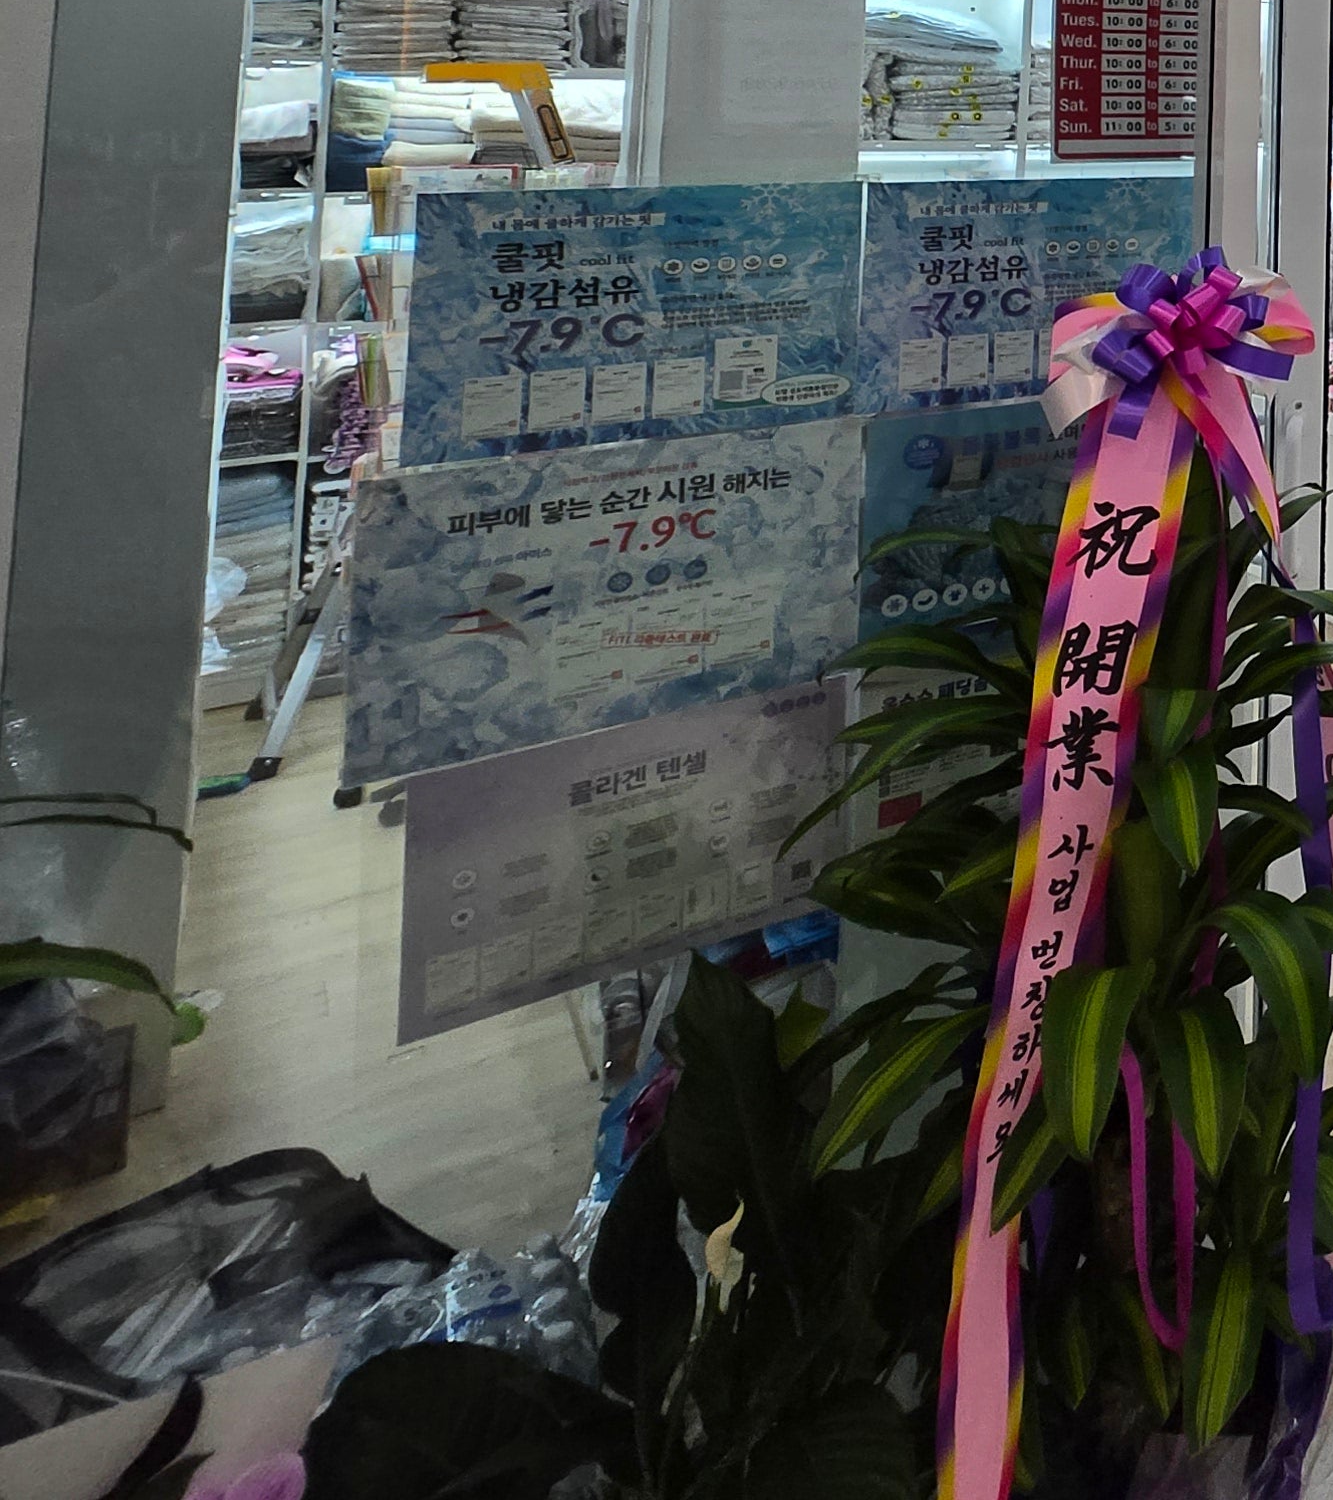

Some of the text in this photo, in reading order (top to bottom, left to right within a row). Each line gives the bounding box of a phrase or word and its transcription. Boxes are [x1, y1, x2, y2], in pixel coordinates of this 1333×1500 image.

[1061, 12, 1100, 28] Tues.
[1149, 17, 1159, 27] to
[1061, 35, 1098, 49] Wed.
[1148, 38, 1158, 48] to
[1060, 55, 1097, 69] Thur.
[1148, 59, 1158, 69] to
[1060, 77, 1083, 90] Fri.
[1147, 80, 1157, 90] to
[1059, 98, 1088, 112] Sat.
[1147, 100, 1157, 110] to
[1059, 120, 1092, 134] Sun.
[1147, 122, 1157, 132] to
[919, 223, 974, 252] 쿨핏
[983, 237, 1008, 247] cool
[491, 240, 635, 274] 쿨핏 cool fit
[918, 255, 1028, 286] 냉감섬유
[489, 275, 640, 313] 냉감섬유
[446, 504, 531, 537] 피부에
[540, 496, 593, 524] 닿는
[599, 486, 652, 514] 순간
[657, 473, 716, 503] 시원
[722, 467, 792, 495] 해지는
[655, 749, 707, 783] 텐셀
[1046, 823, 1095, 915] 사업
